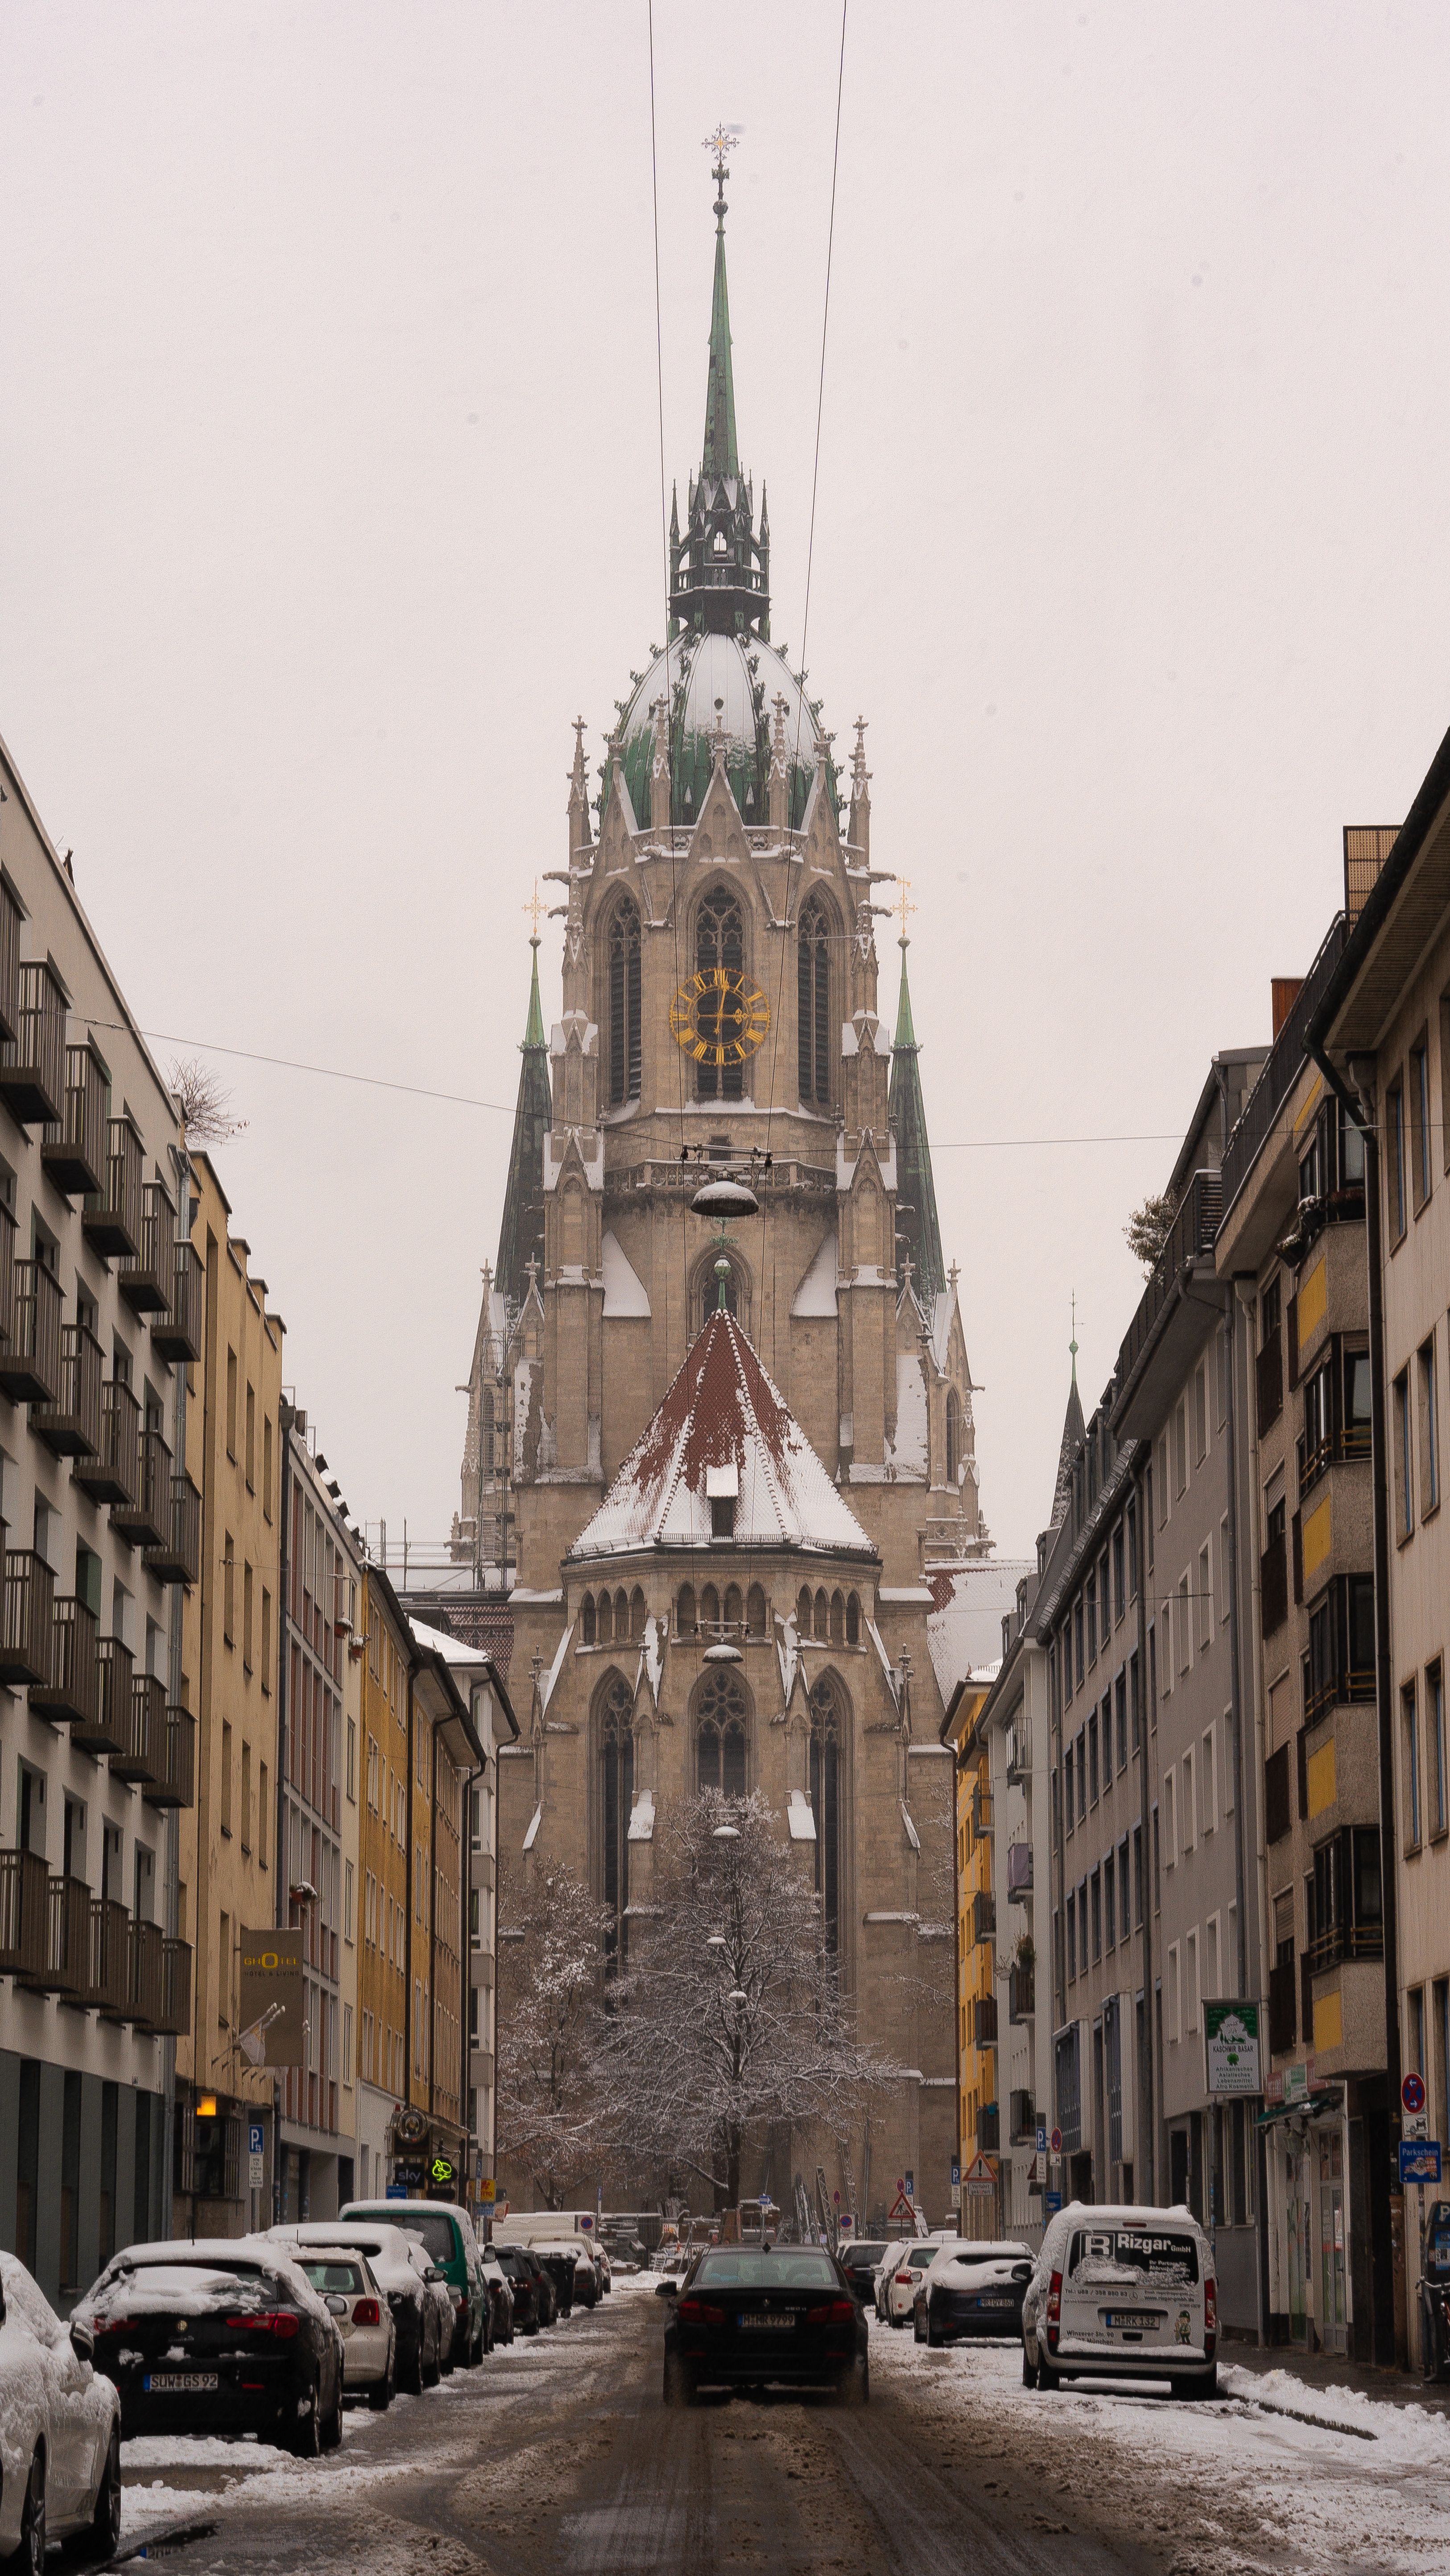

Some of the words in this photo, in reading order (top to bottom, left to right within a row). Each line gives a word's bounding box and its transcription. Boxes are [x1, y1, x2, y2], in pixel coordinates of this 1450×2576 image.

[244, 1952, 299, 1969] GHOTEL
[251, 2129, 259, 2150] P
[1038, 2131, 1043, 2149] P
[1402, 2148, 1438, 2156] Parkschein
[398, 2168, 421, 2183] sky
[953, 2168, 958, 2182] P
[906, 2181, 911, 2193] P
[1085, 2235, 1110, 2255] R
[1117, 2233, 1172, 2255] Rizgar
[1171, 2245, 1191, 2253] GmbH
[770, 2314, 794, 2325] 9799
[1115, 2316, 1120, 2325] M
[1126, 2316, 1137, 2325] RK
[1139, 2316, 1155, 2326] 132
[183, 2374, 199, 2387] GS
[202, 2374, 217, 2387] 92
